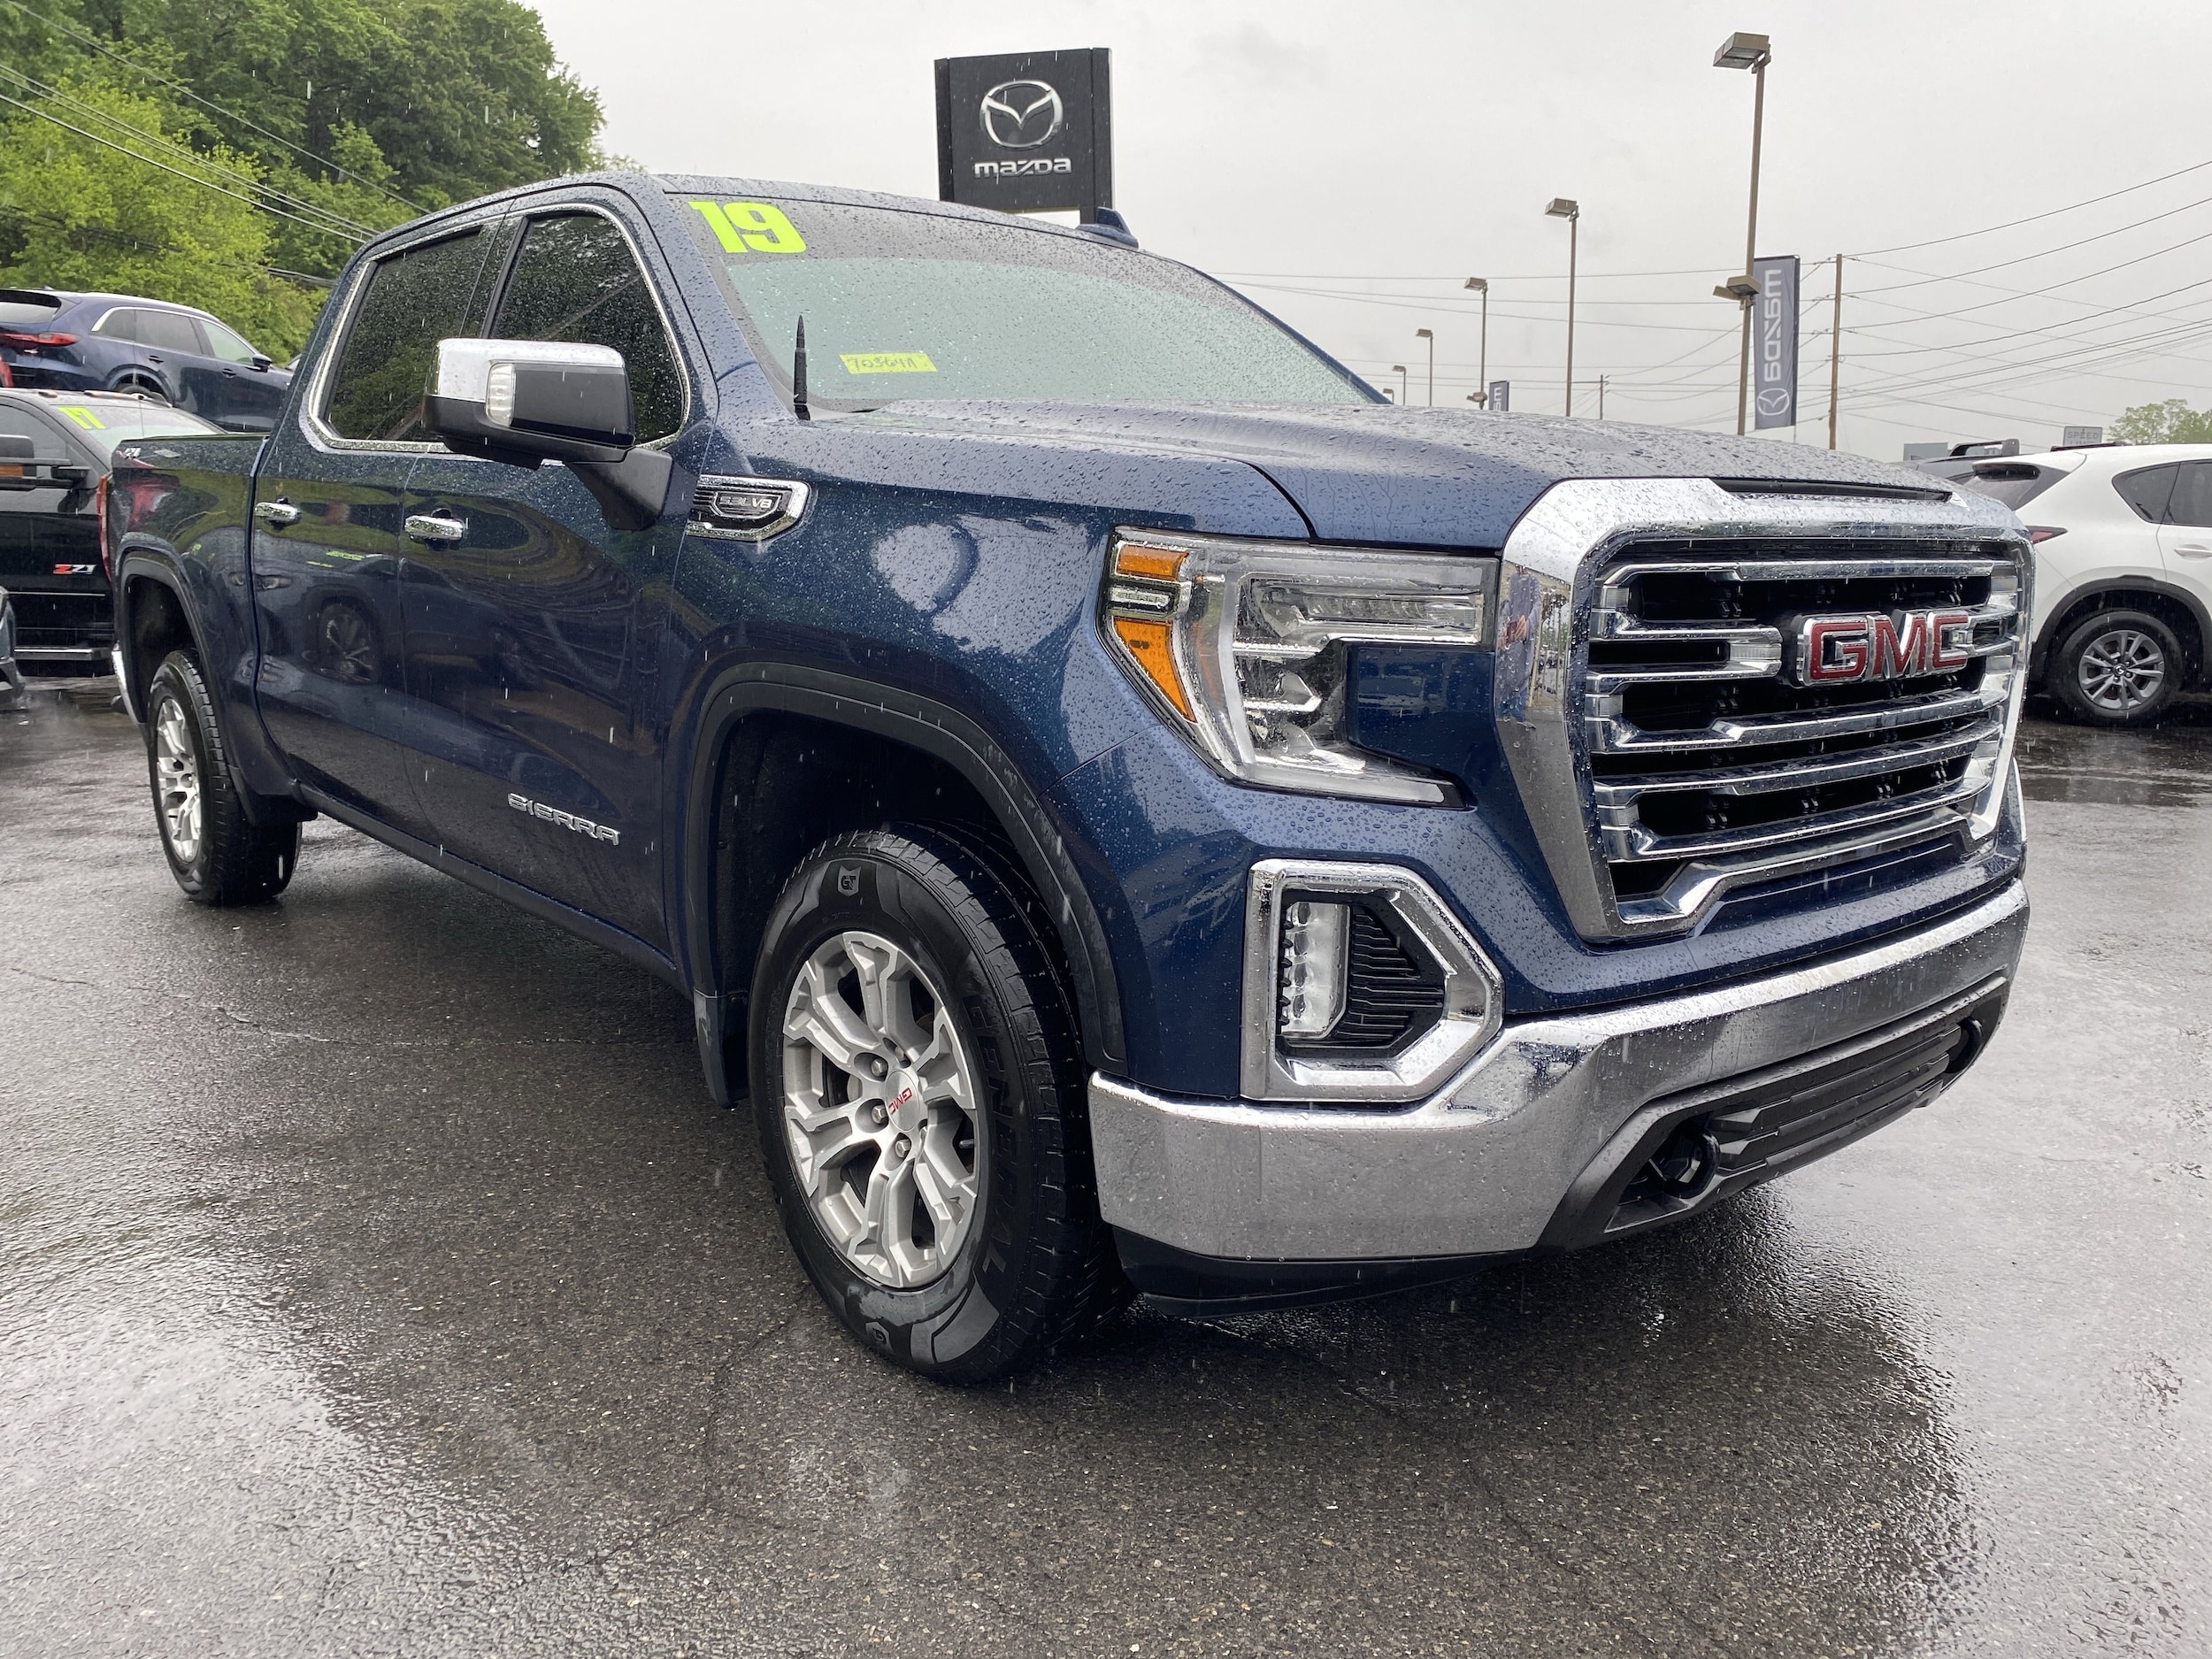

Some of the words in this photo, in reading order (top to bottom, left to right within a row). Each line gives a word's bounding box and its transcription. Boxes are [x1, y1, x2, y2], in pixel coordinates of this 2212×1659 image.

[974, 157, 1072, 179] mazda
[687, 201, 807, 254] 19
[57, 406, 106, 430] 17
[2067, 431, 2100, 440] SPEED
[751, 497, 772, 509] V8
[53, 564, 96, 575] Z71
[1799, 610, 1969, 687] GMC
[508, 793, 621, 846] SIERRA
[887, 1087, 913, 1115] GMC
